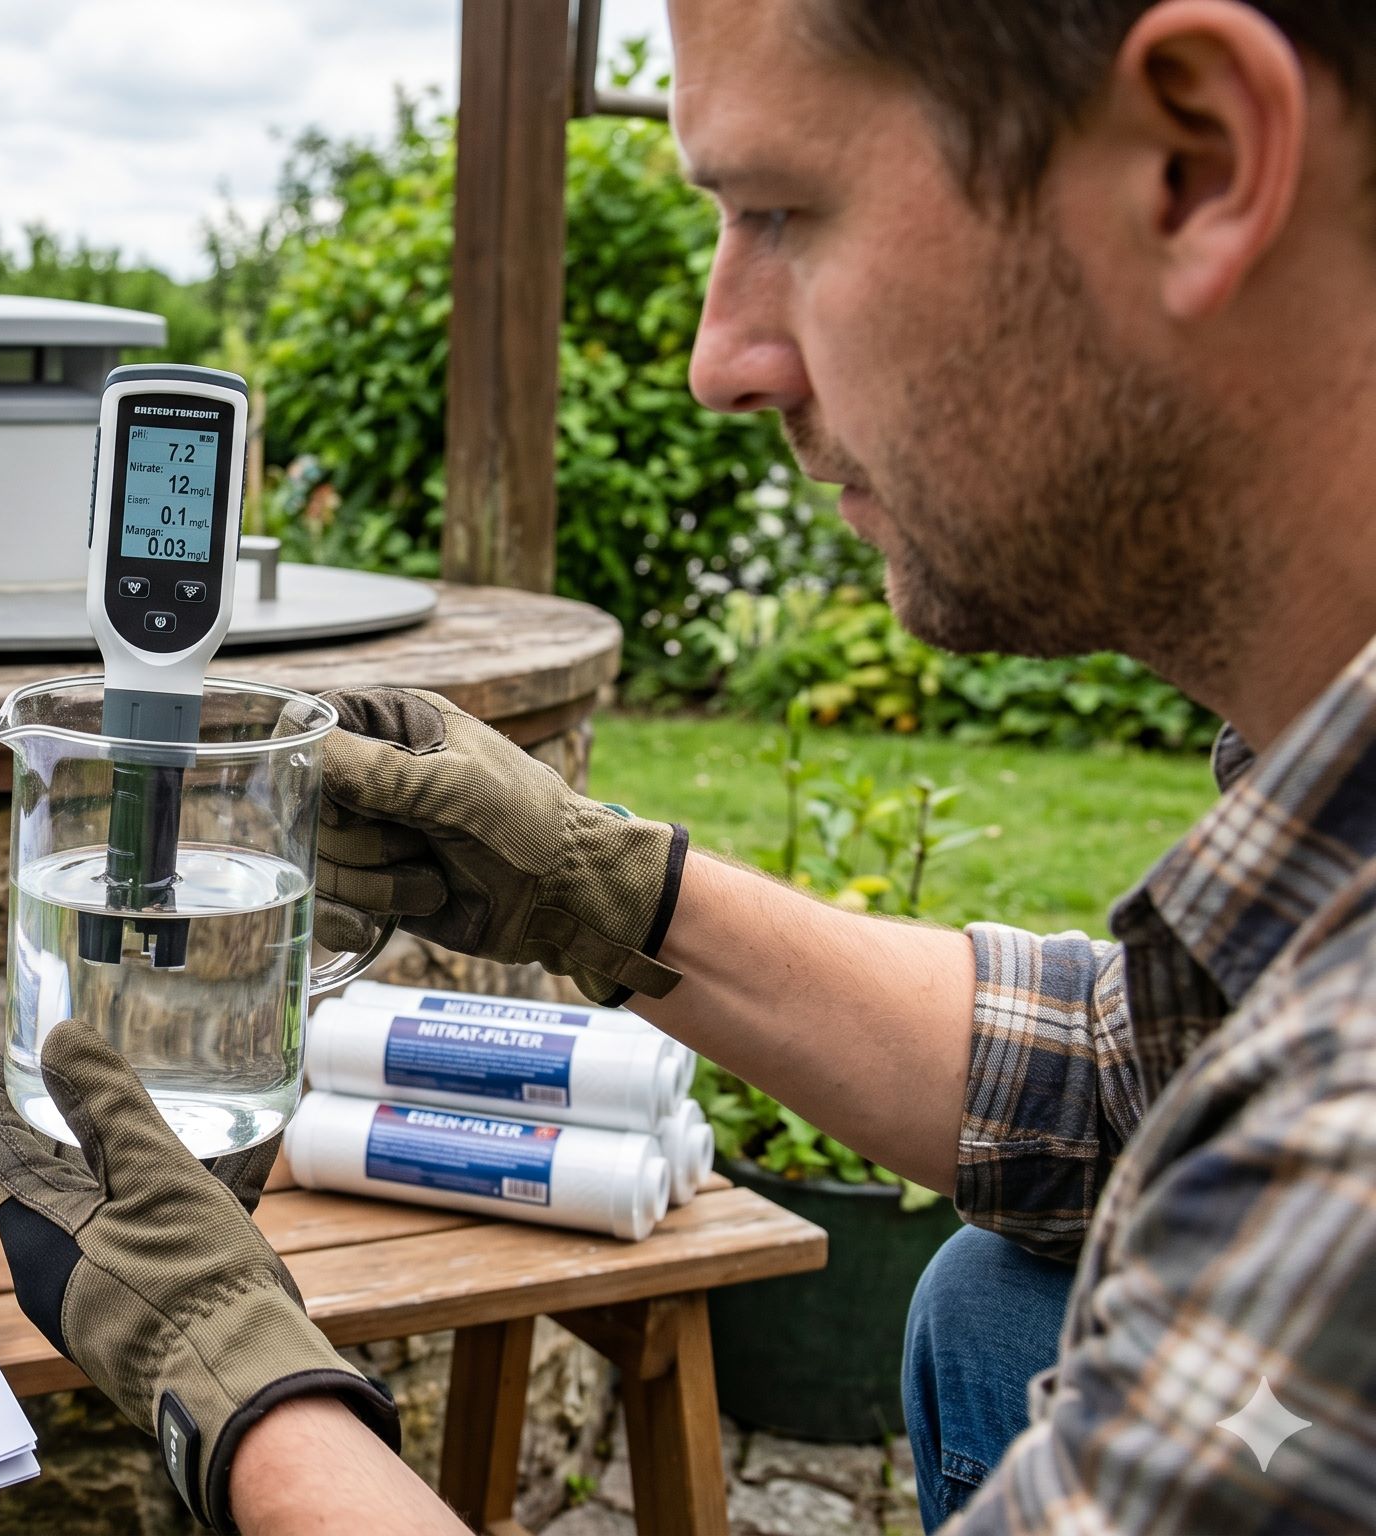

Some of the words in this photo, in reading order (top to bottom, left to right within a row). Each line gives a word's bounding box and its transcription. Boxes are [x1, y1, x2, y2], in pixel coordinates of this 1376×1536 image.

[168, 443, 195, 463] 7.2
[129, 462, 164, 474] Nitrate:
[169, 475, 189, 495] 12
[190, 487, 212, 497] mg/L
[127, 495, 150, 505] Eisen:
[160, 505, 186, 526] 0.1
[189, 518, 210, 528] mg/L
[125, 525, 164, 537] Mangan:
[147, 537, 186, 558] 0.03
[187, 551, 209, 562] mg/L
[443, 1000, 562, 1024] NITRAT-FILTER
[417, 1021, 544, 1049] NITRAT-FILTER
[406, 1109, 523, 1139] EISEN-FILTER
